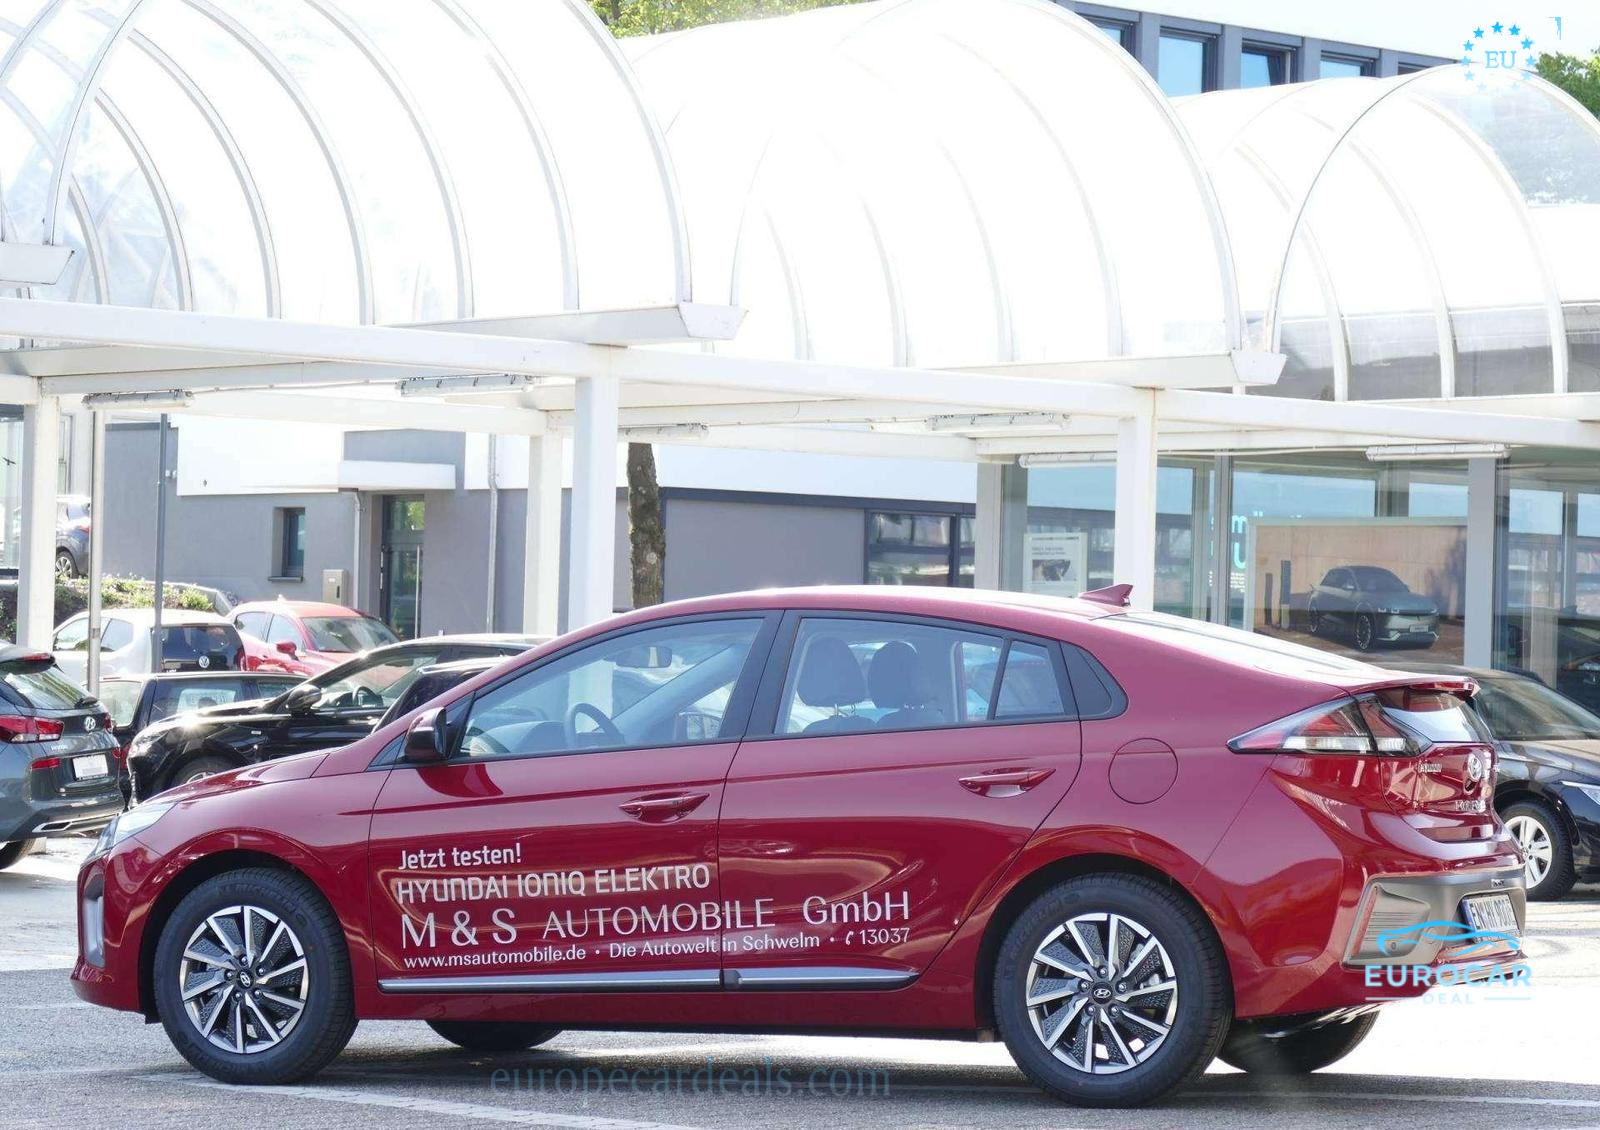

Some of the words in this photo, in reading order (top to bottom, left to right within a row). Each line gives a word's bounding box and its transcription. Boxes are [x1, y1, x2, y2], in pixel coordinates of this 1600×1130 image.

[398, 847, 446, 870] Jetzt
[451, 842, 522, 868] testen!
[397, 874, 509, 905] HYUNDAI
[517, 870, 586, 898] IONIQ
[595, 864, 710, 892] ELEKTRO
[401, 912, 436, 949] M
[450, 910, 479, 947] &
[491, 908, 517, 944] S
[542, 898, 776, 939] AUTOMOBILE
[802, 890, 910, 926] GmbH
[404, 944, 586, 968] www.msautomobile.de
[609, 942, 636, 958] Die
[641, 938, 717, 956] Autowelt
[722, 937, 737, 953] in
[742, 931, 820, 951] Schwelm
[859, 927, 911, 945] 13037
